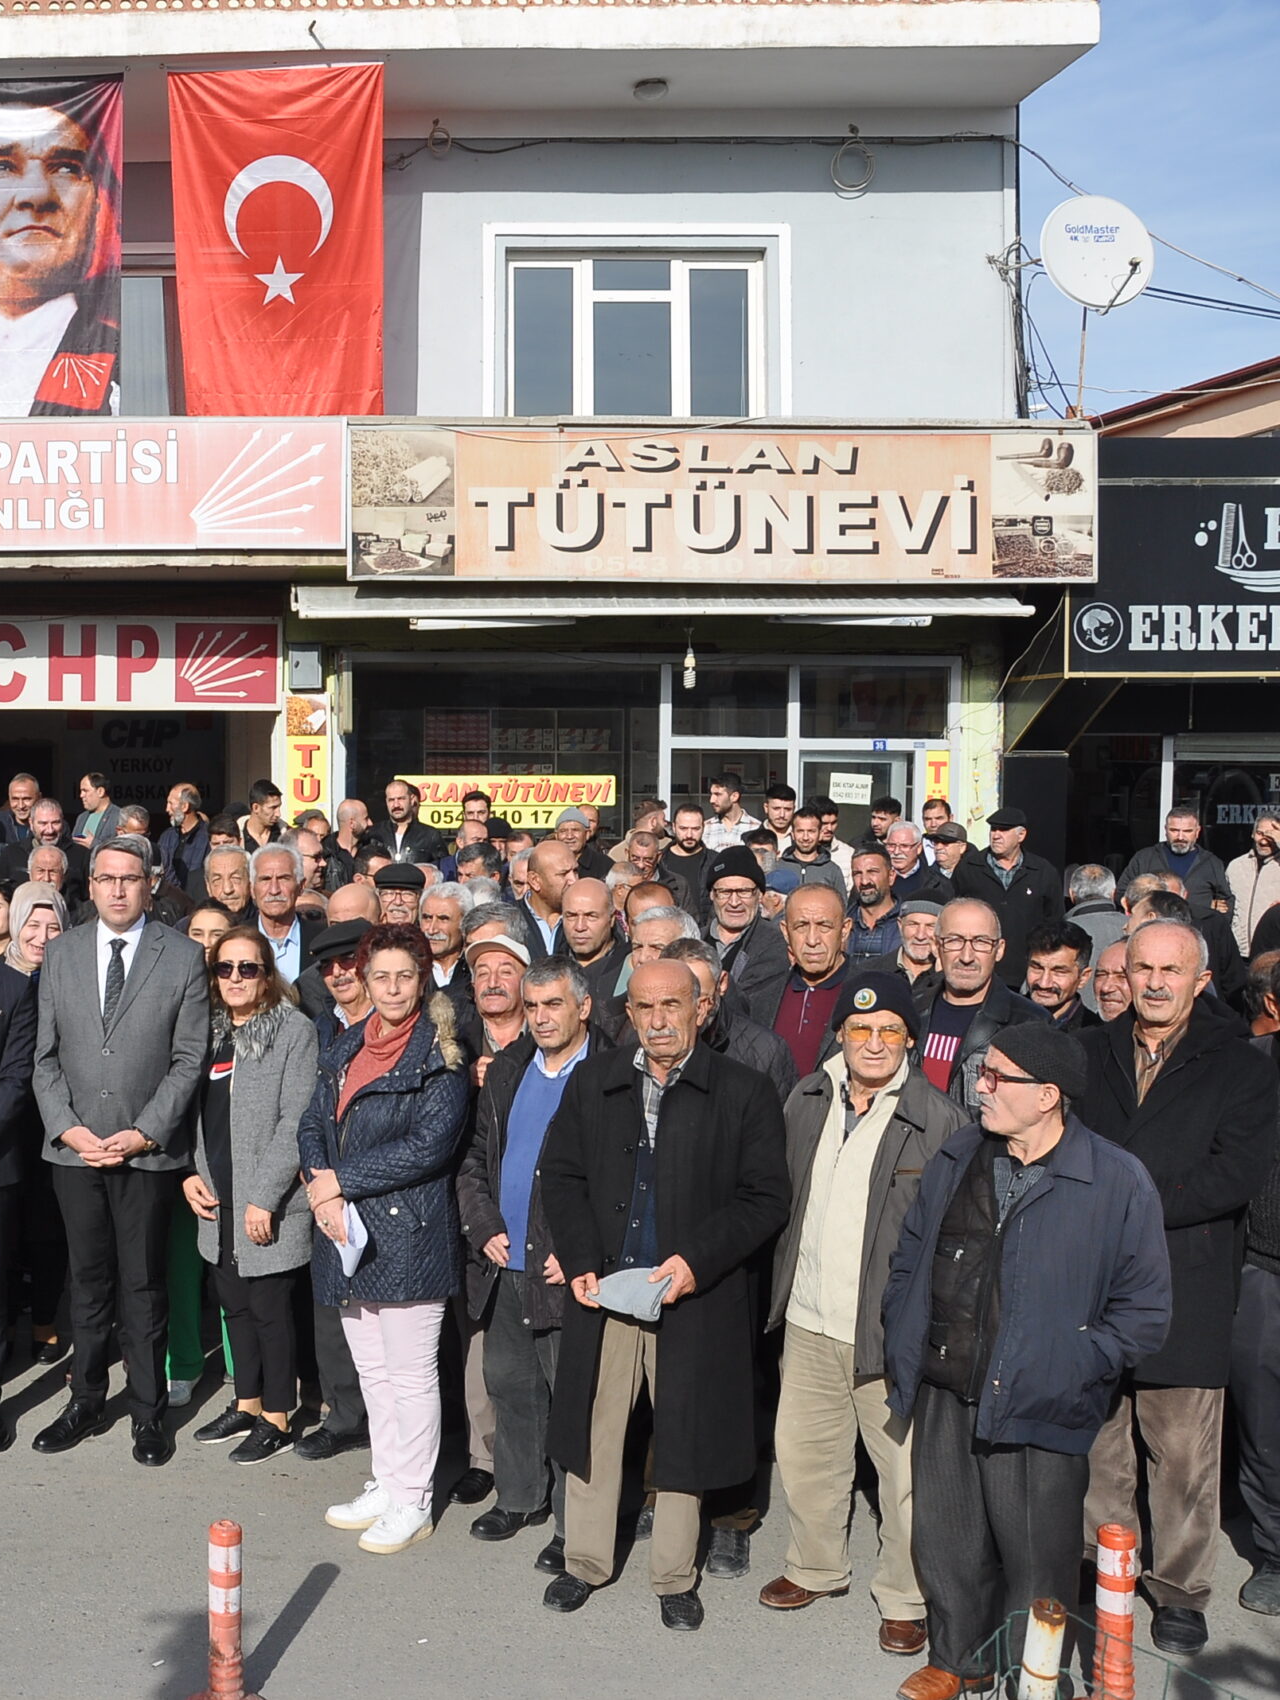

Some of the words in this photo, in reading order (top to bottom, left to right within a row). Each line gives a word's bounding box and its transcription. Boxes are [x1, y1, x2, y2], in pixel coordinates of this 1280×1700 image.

[1065, 223, 1120, 234] GoldMaster
[564, 440, 859, 475] ASLAN
[468, 474, 978, 554] TÜTÜNEVİ
[683, 557, 744, 574] 410
[760, 558, 796, 574] 17
[102, 719, 180, 749] CHP
[420, 782, 478, 802] SLAN
[488, 778, 612, 803] TÜTÜNEVİ
[431, 810, 465, 824] 054
[531, 810, 553, 824] 17
